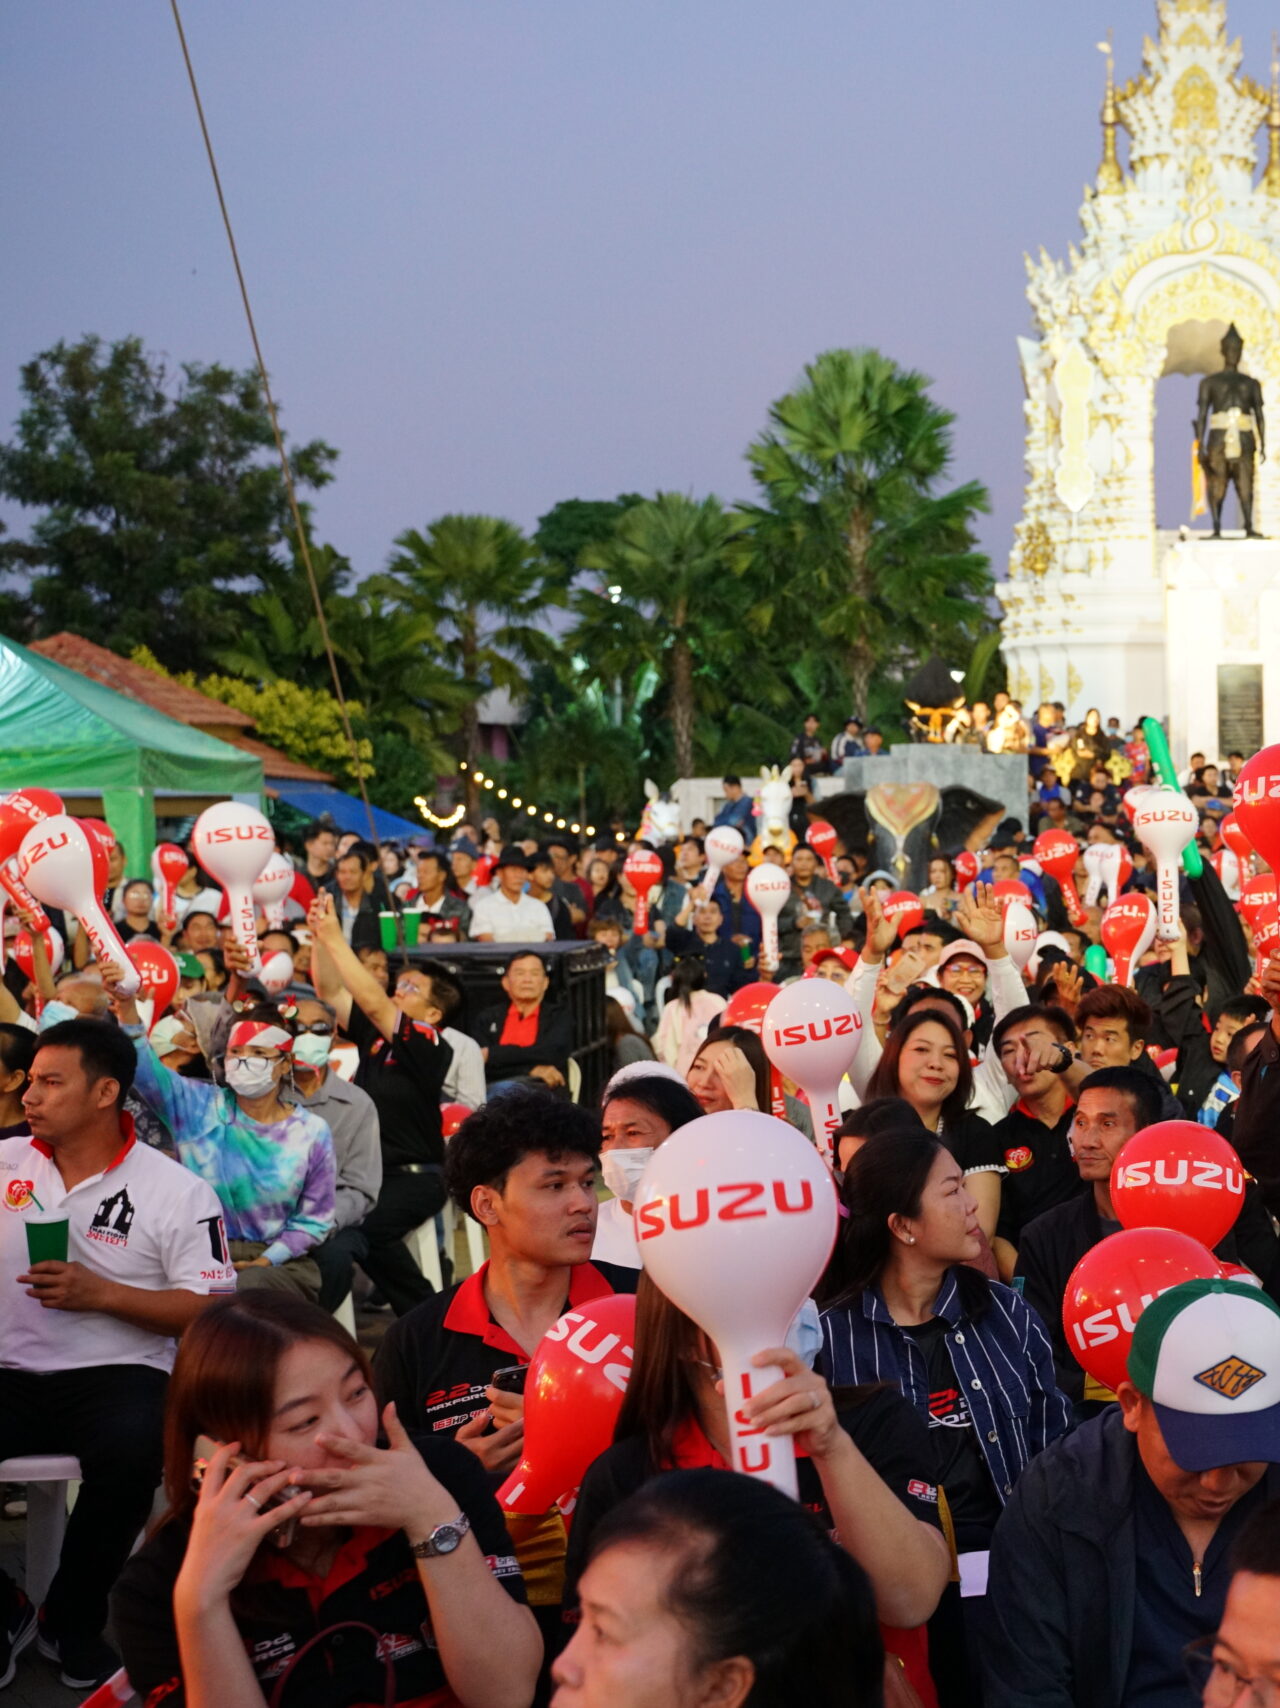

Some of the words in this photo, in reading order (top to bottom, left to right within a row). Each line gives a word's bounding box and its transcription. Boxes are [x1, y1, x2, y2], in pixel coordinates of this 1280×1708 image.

[1137, 810, 1193, 826] ISUZU
[1162, 869, 1174, 925] ISUZU
[240, 896, 258, 958] ISUZU
[774, 1012, 863, 1048] ISUZU
[1117, 1159, 1244, 1195] ISUZU
